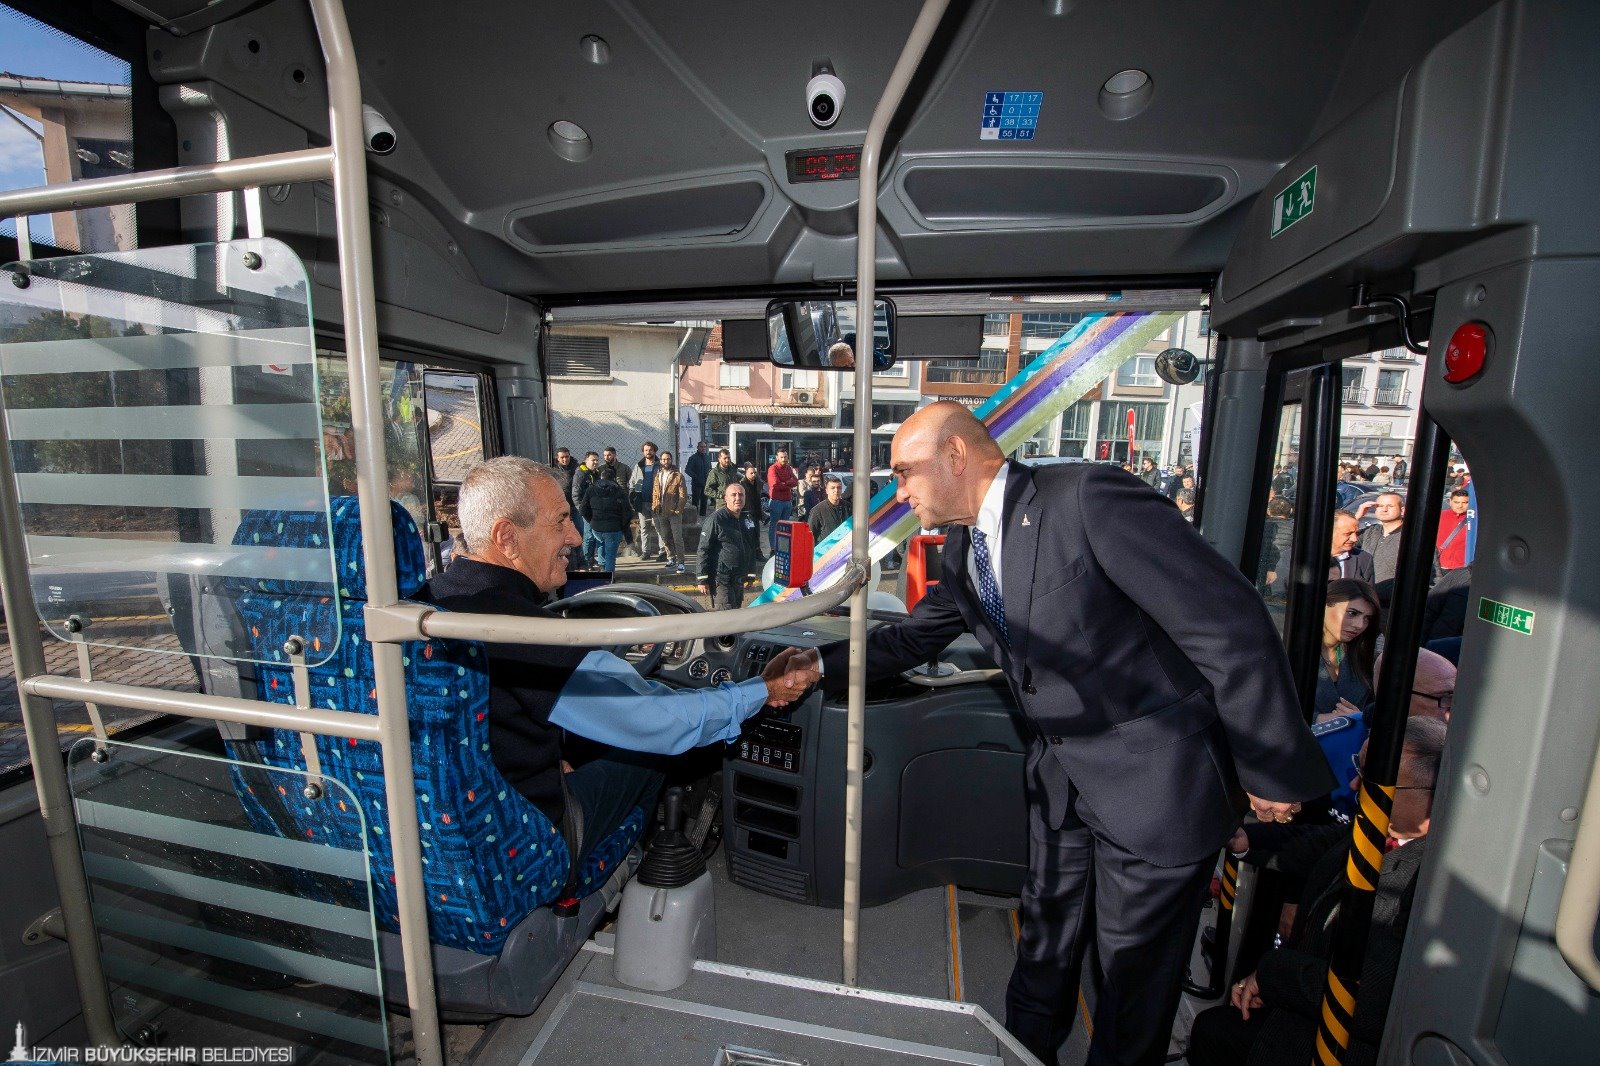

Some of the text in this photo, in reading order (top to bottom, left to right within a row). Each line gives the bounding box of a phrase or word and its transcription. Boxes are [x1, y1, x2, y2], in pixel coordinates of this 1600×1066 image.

[1009, 94, 1038, 102] 17 17
[1008, 106, 1015, 114] 0
[1004, 118, 1033, 126] 38 33
